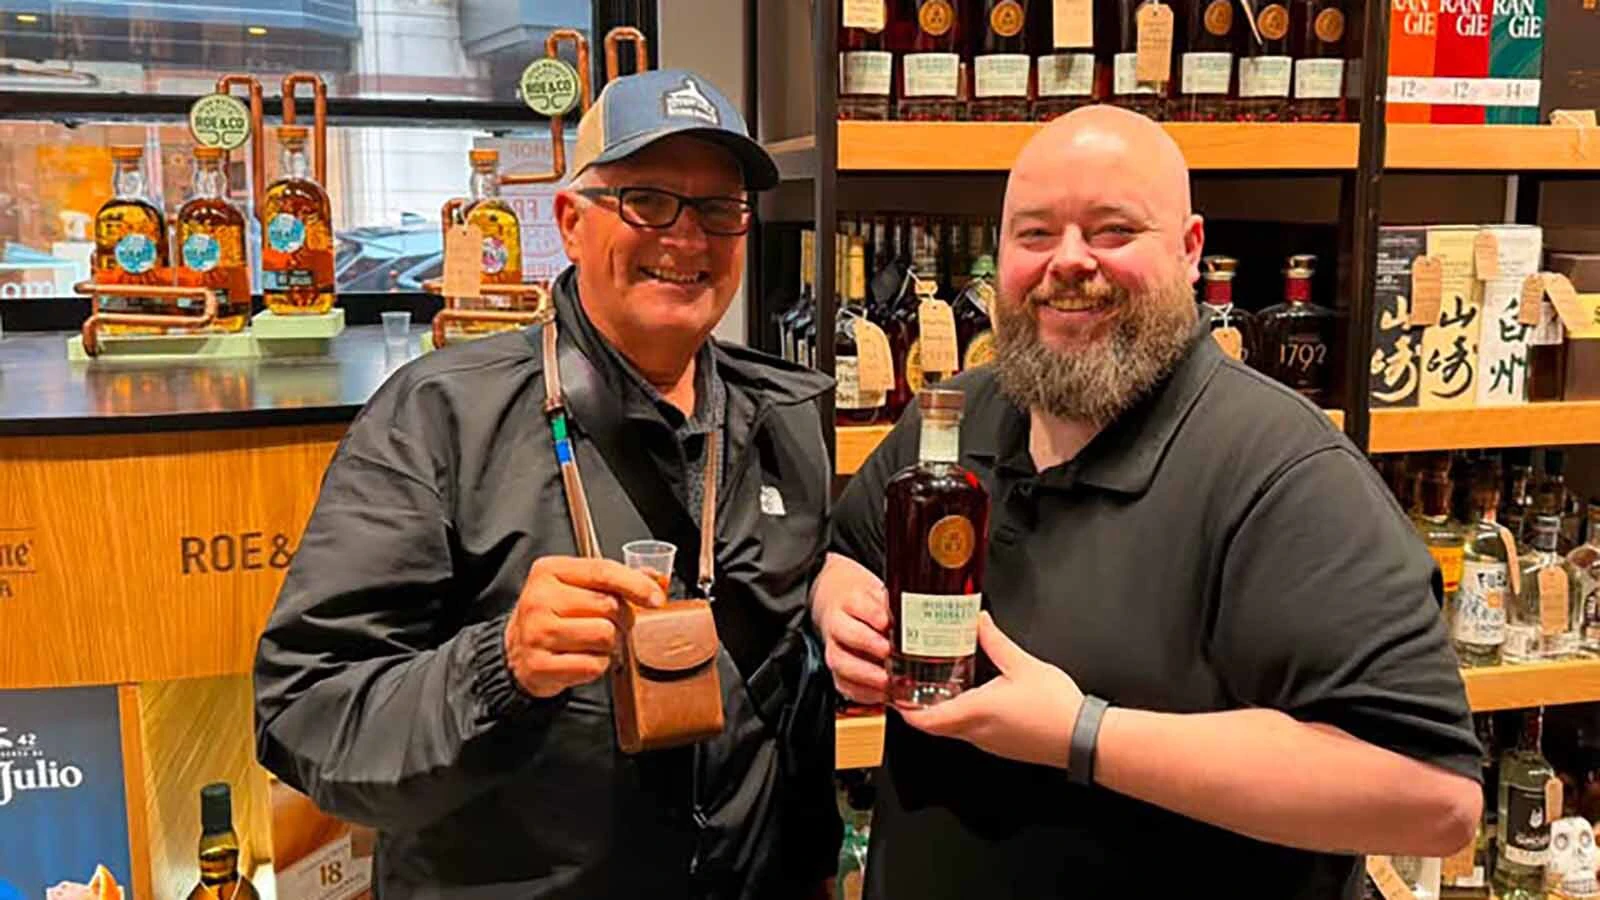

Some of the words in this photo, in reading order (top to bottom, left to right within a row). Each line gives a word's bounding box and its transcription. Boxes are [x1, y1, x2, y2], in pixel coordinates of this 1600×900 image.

[1404, 13, 1436, 36] GIE
[1456, 14, 1489, 37] GIE
[1508, 16, 1542, 38] GIE
[1280, 343, 1327, 370] 1792
[17, 733, 37, 745] 42
[0, 759, 83, 806] Julio
[320, 860, 343, 887] 18
